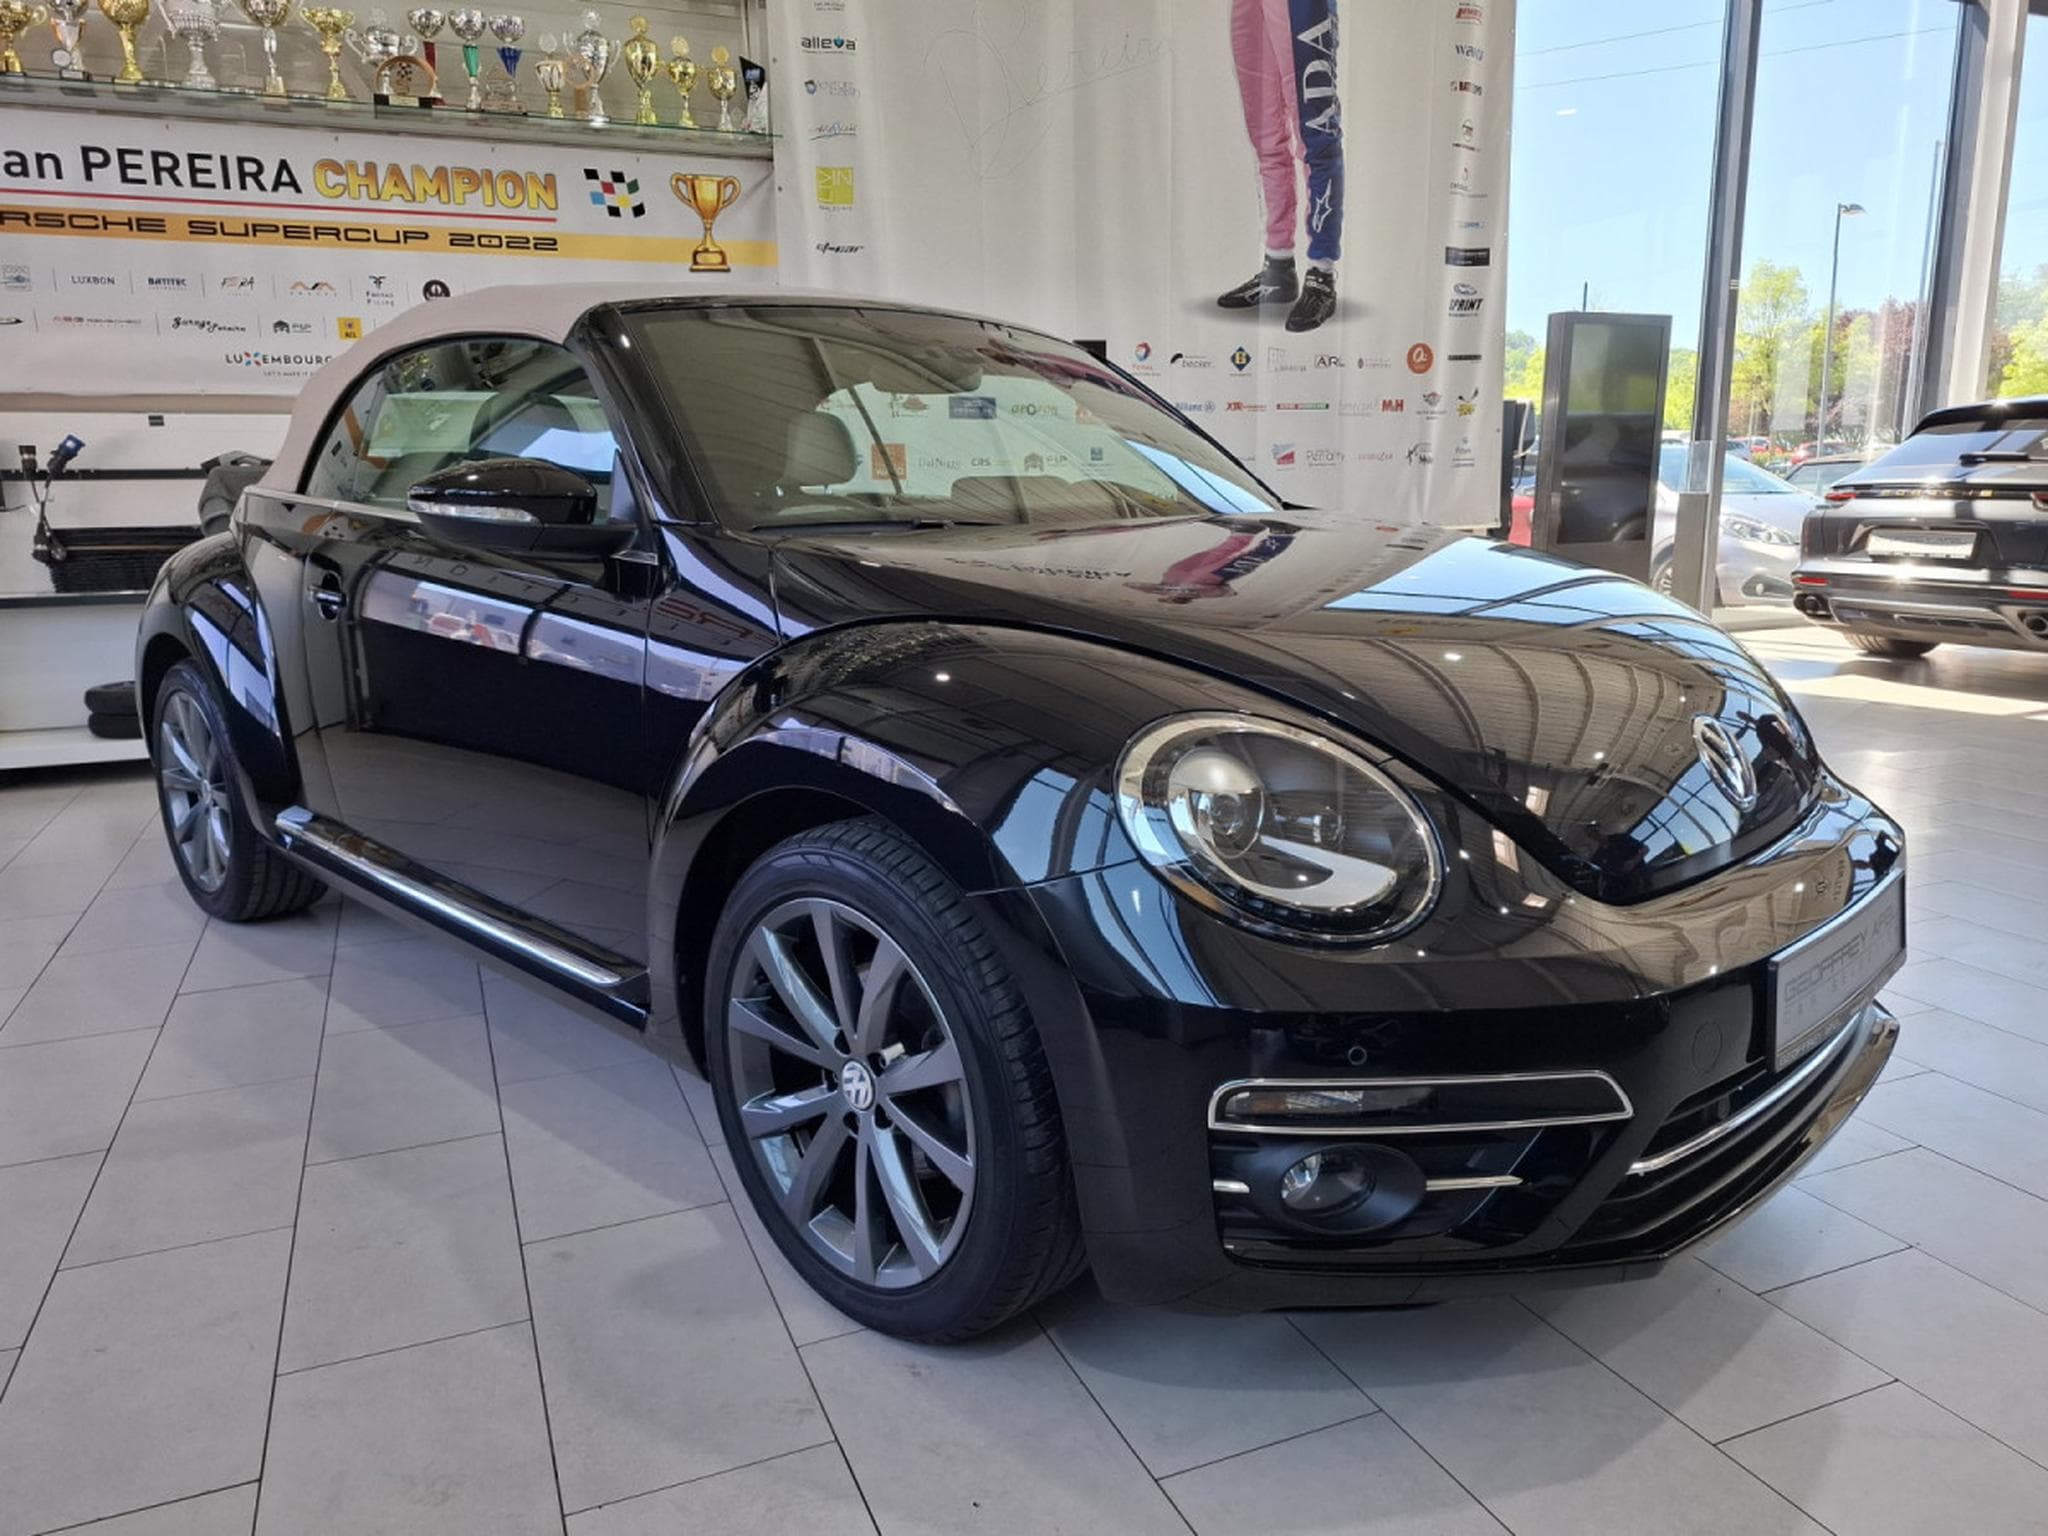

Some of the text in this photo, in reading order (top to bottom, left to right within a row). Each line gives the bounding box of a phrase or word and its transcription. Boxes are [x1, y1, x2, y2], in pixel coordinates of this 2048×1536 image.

[3, 146, 559, 211] an PEREIRA CHAMPION
[0, 211, 559, 251] RSCHE SUPERCUP 2022
